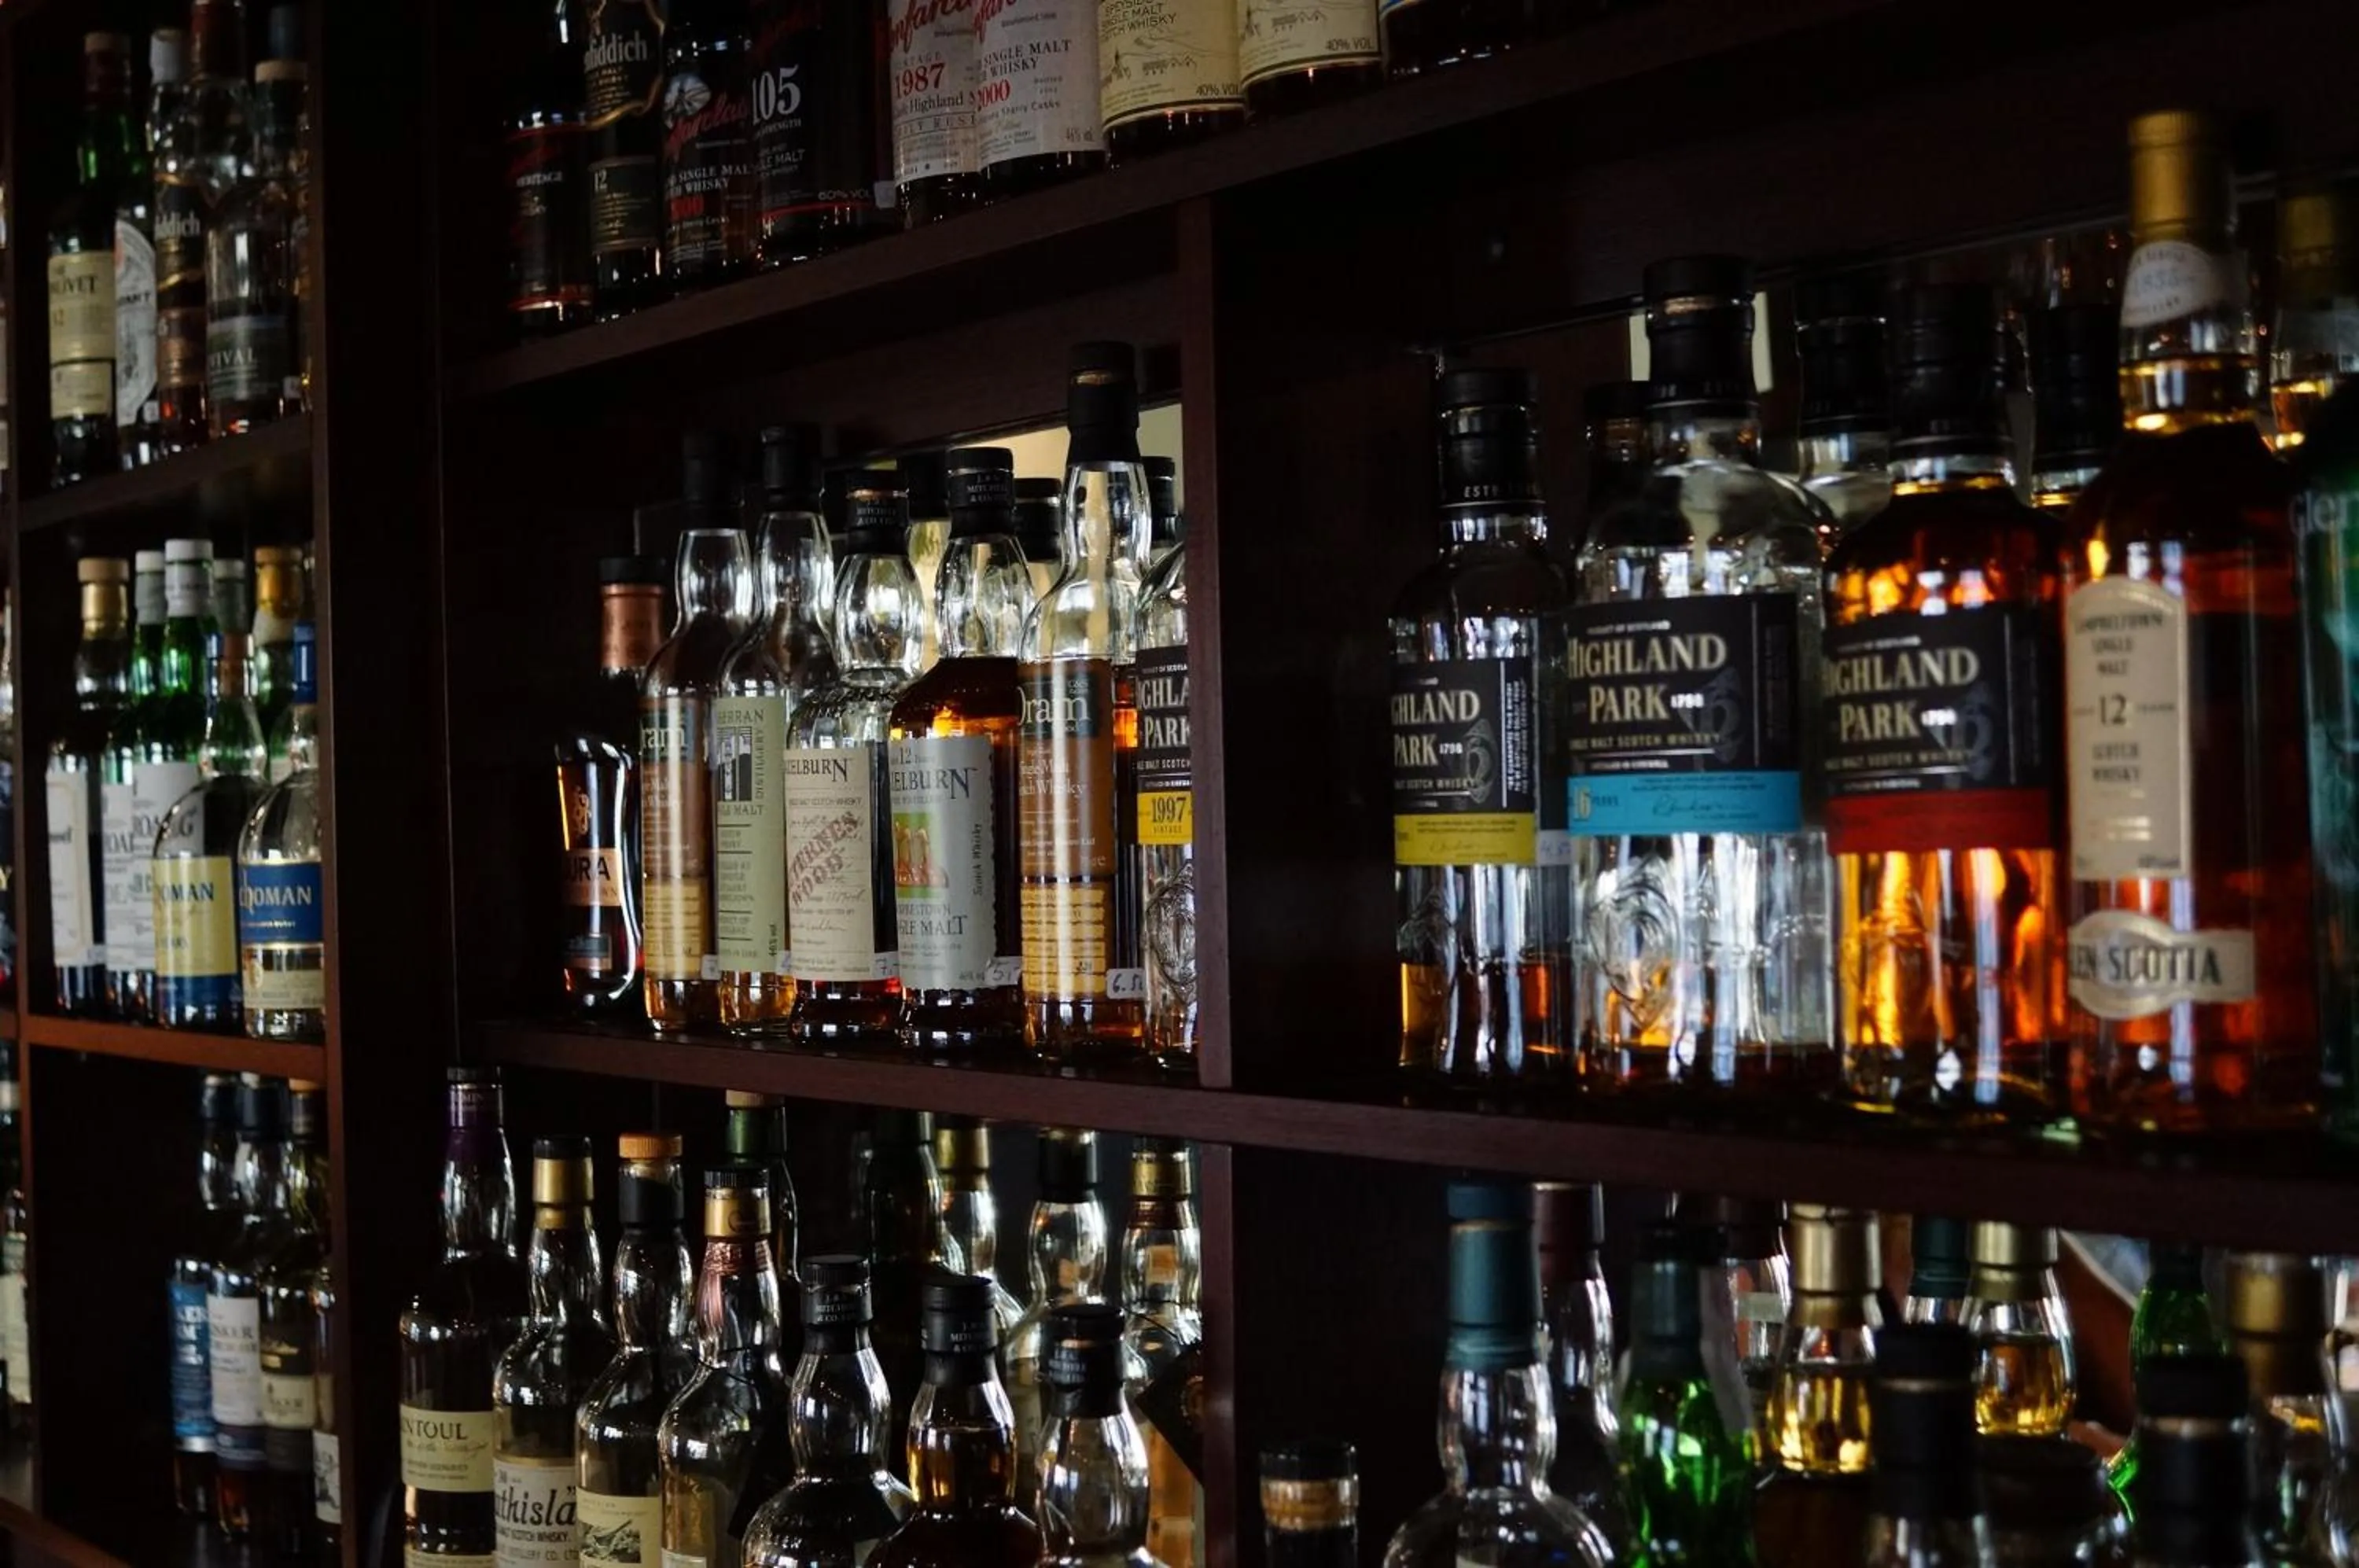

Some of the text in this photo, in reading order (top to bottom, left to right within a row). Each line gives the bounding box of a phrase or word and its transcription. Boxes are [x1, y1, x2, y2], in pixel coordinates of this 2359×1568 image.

[1029, 39, 1071, 54] MALT
[894, 62, 945, 100] 1987
[990, 55, 1039, 77] WHISKY
[751, 64, 802, 127] 105
[910, 91, 964, 114] Highland
[593, 167, 608, 193] 12
[678, 165, 716, 184] SINGLE
[720, 163, 752, 176] MAL
[683, 177, 730, 196] WHISKY
[1566, 632, 1728, 679] HIGHLAND
[1135, 677, 1191, 709] GHLA
[1588, 683, 1672, 724] PARK
[1838, 699, 1922, 743] PARK
[2099, 693, 2127, 727] 12
[899, 747, 912, 765] 12
[1394, 733, 1439, 767] PARK
[1152, 796, 1187, 824] 1997
[921, 915, 968, 936] MALT
[2107, 945, 2223, 987] SCOTIA
